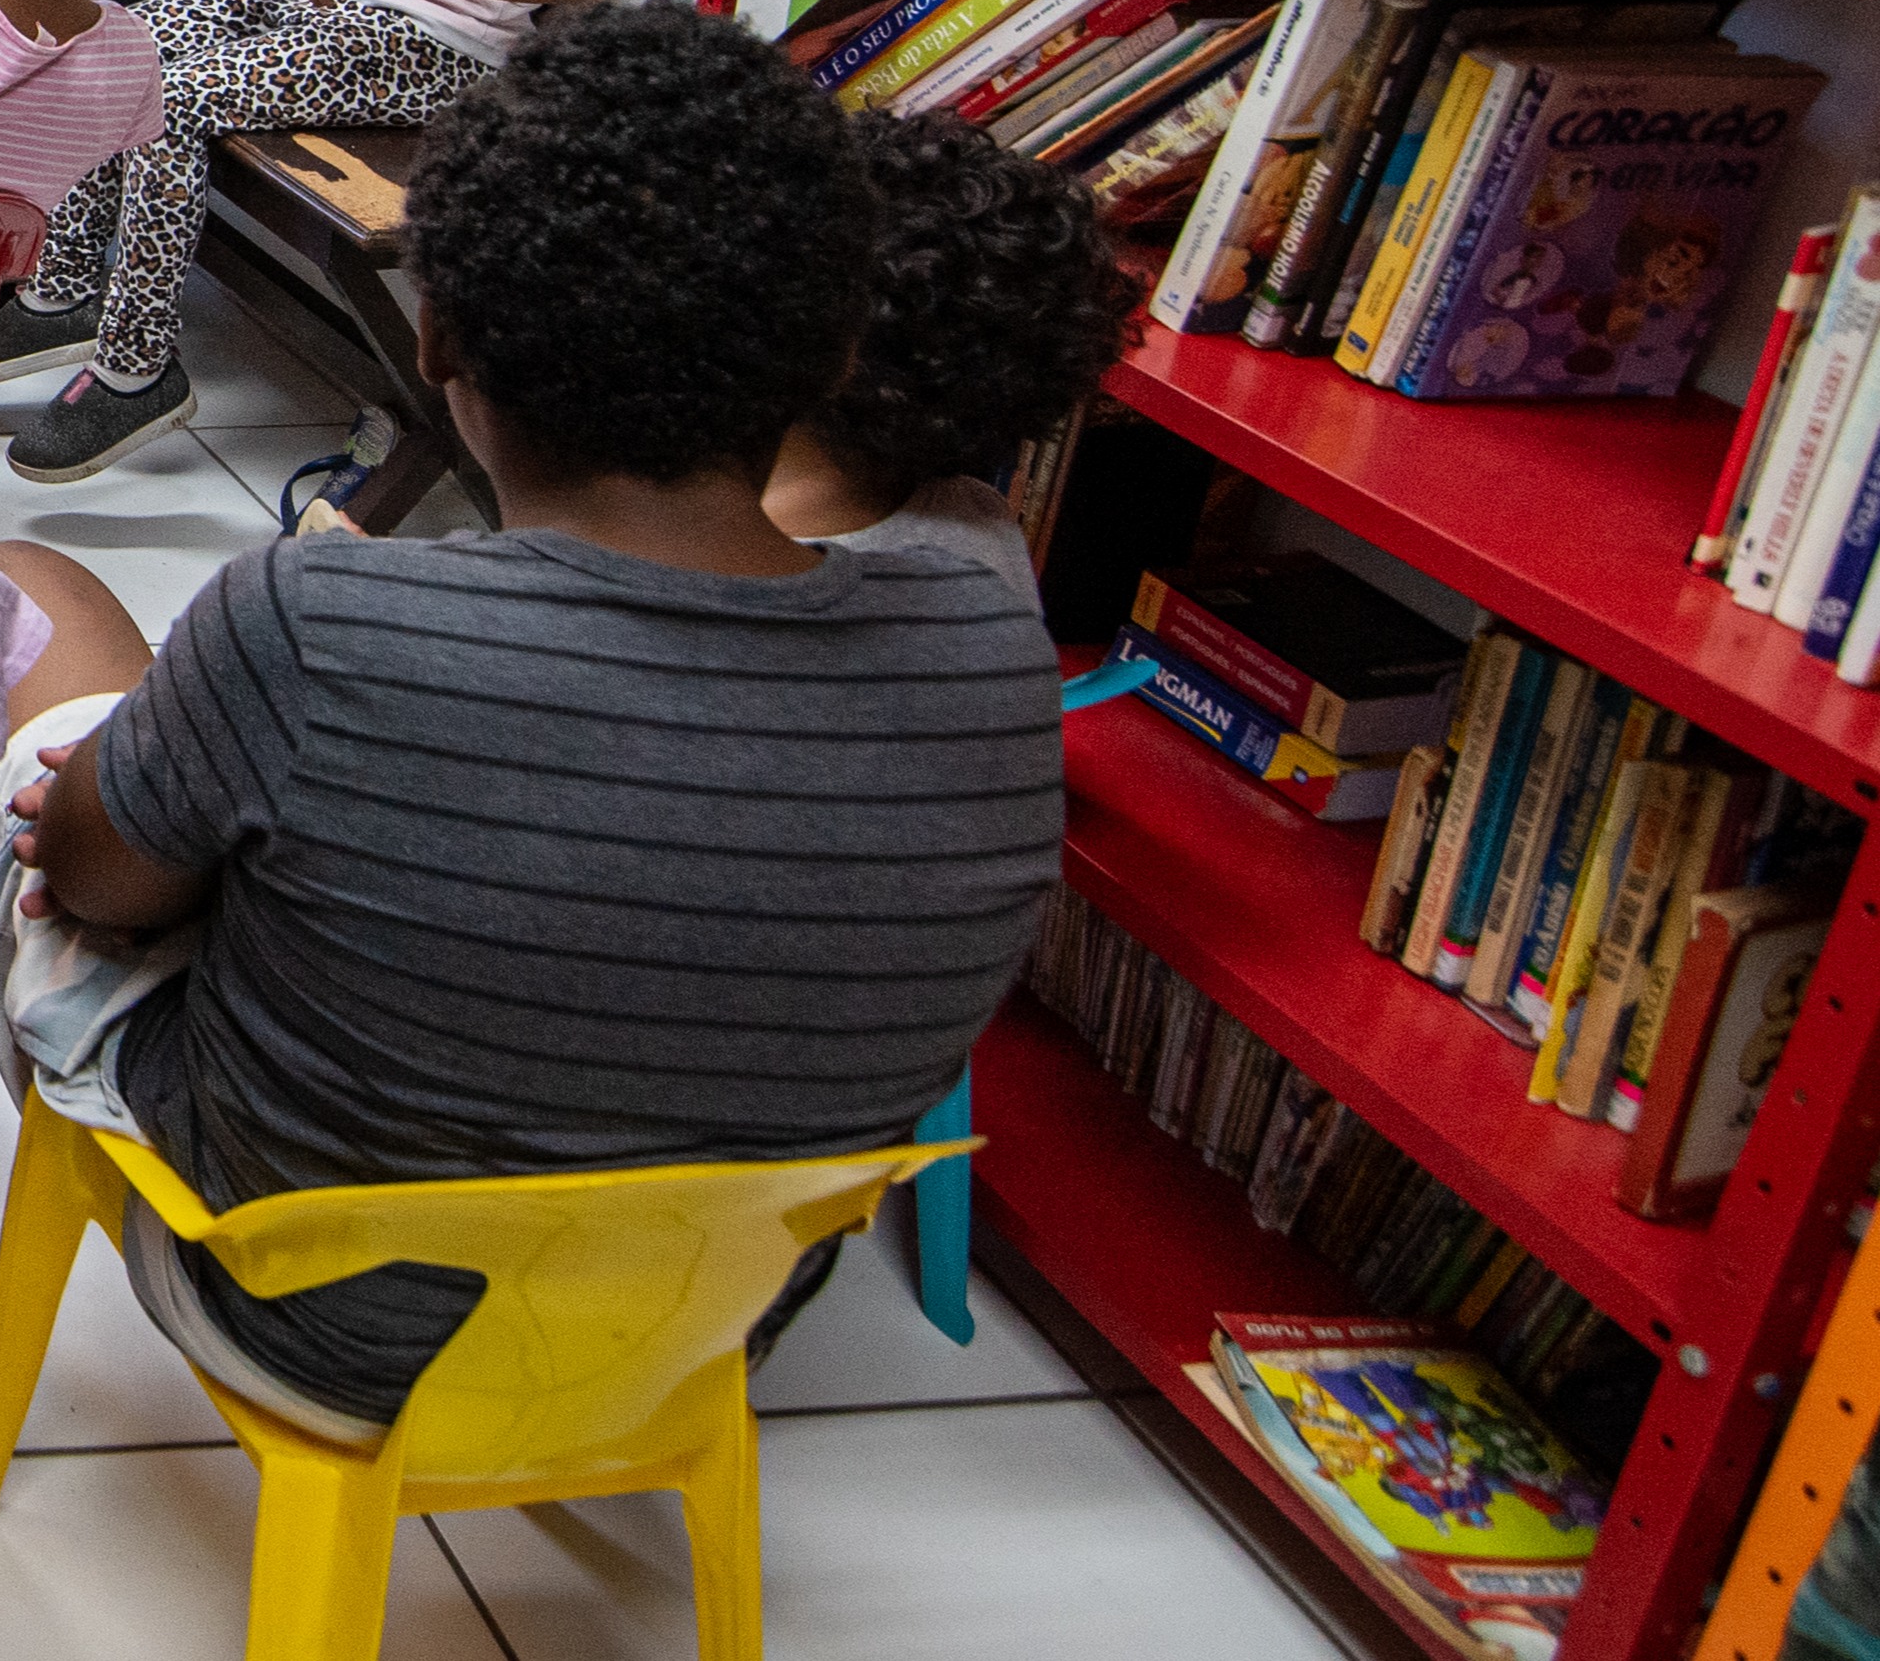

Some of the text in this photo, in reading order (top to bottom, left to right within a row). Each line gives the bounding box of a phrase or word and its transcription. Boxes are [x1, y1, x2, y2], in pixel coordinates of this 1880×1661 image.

[956, 3, 983, 30] A
[841, 45, 863, 67] O
[857, 19, 896, 54] SEU
[919, 17, 963, 56] vida
[895, 43, 927, 74] do
[1207, 168, 1235, 207] Carlos
[1265, 158, 1334, 292] ALCOOLISMO HOJE
[1117, 636, 1235, 732] LNGMAN
[1244, 1321, 1308, 1340] TUDO
